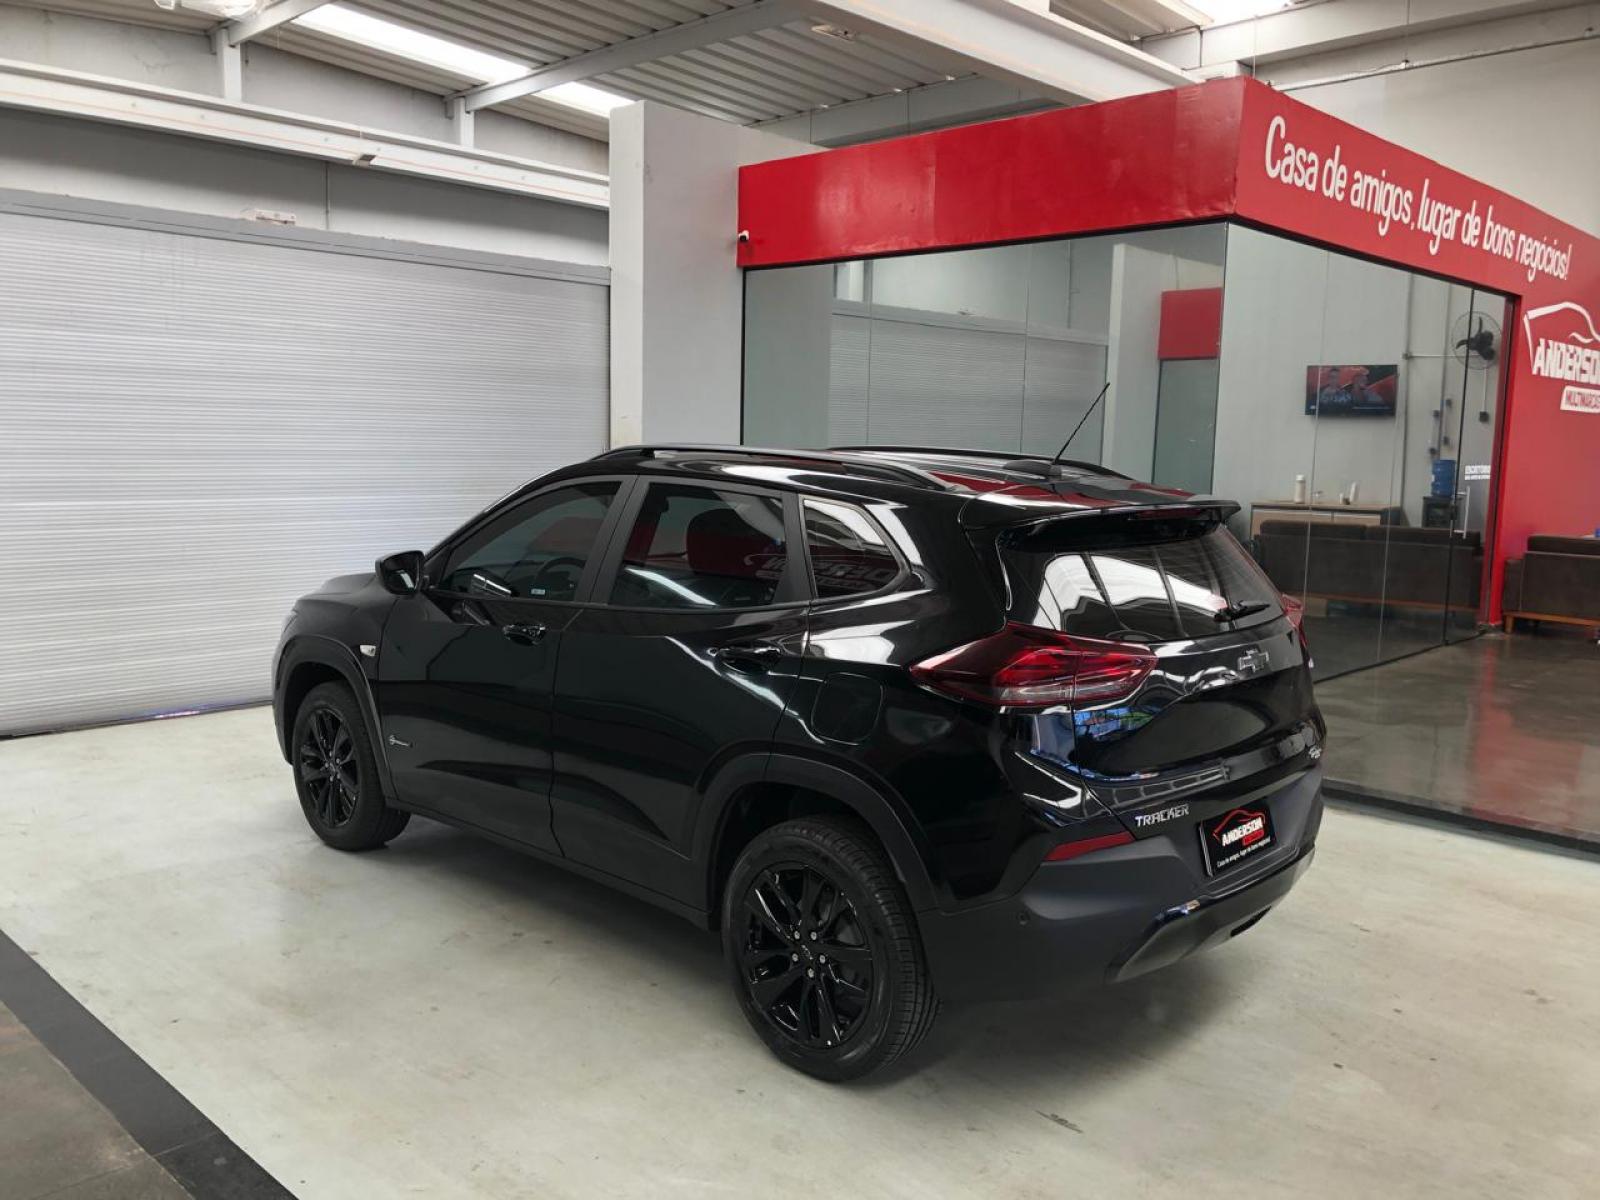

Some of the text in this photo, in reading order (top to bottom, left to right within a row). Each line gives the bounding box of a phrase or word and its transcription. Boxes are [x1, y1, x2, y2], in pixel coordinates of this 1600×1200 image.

[1265, 115, 1572, 282] Casa de amigos, lugar de bons negócios!
[1134, 803, 1189, 827] TRACKER
[1221, 816, 1263, 847] ANDERSON
